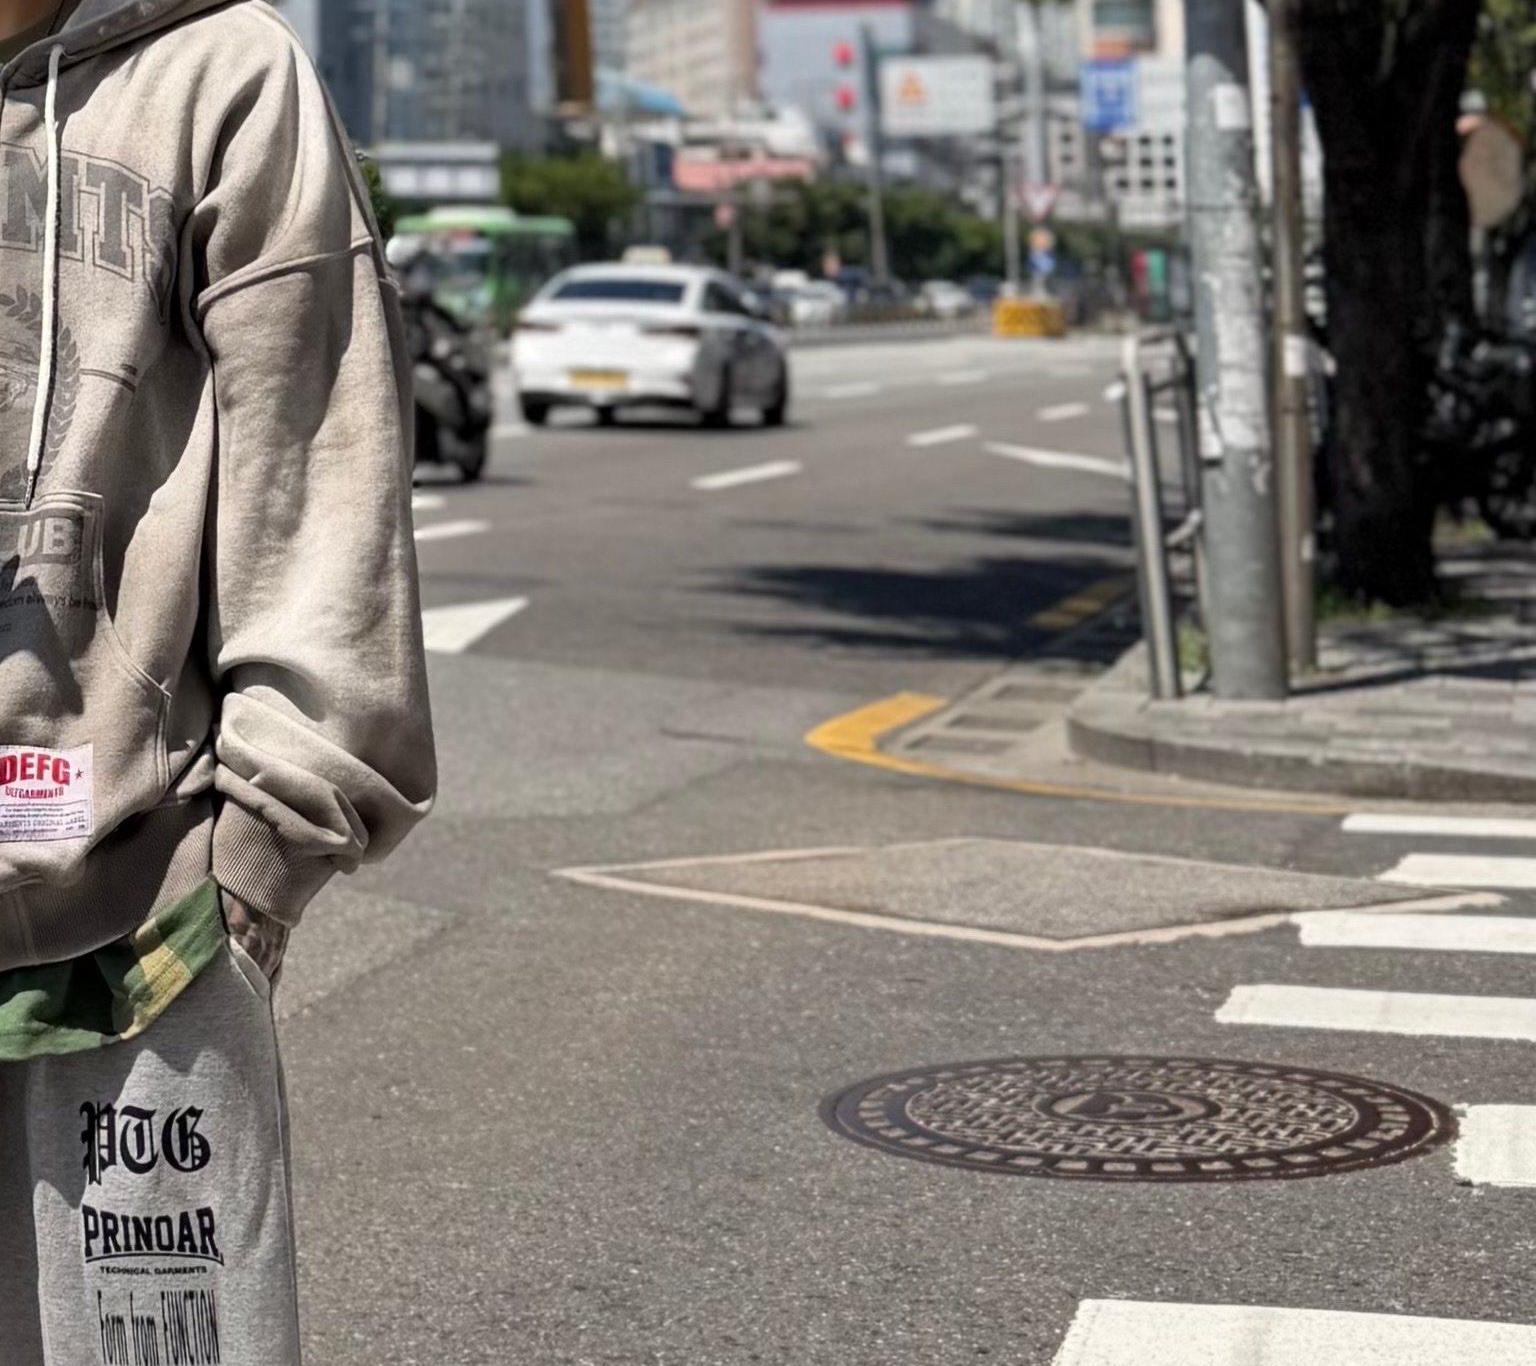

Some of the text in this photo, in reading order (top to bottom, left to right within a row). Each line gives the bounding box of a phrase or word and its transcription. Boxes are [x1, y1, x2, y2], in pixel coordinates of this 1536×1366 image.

[79, 1101, 212, 1185] PTG
[82, 1204, 220, 1259] PRINOAR
[99, 1265, 208, 1276] TECHNICAL GARMENTS
